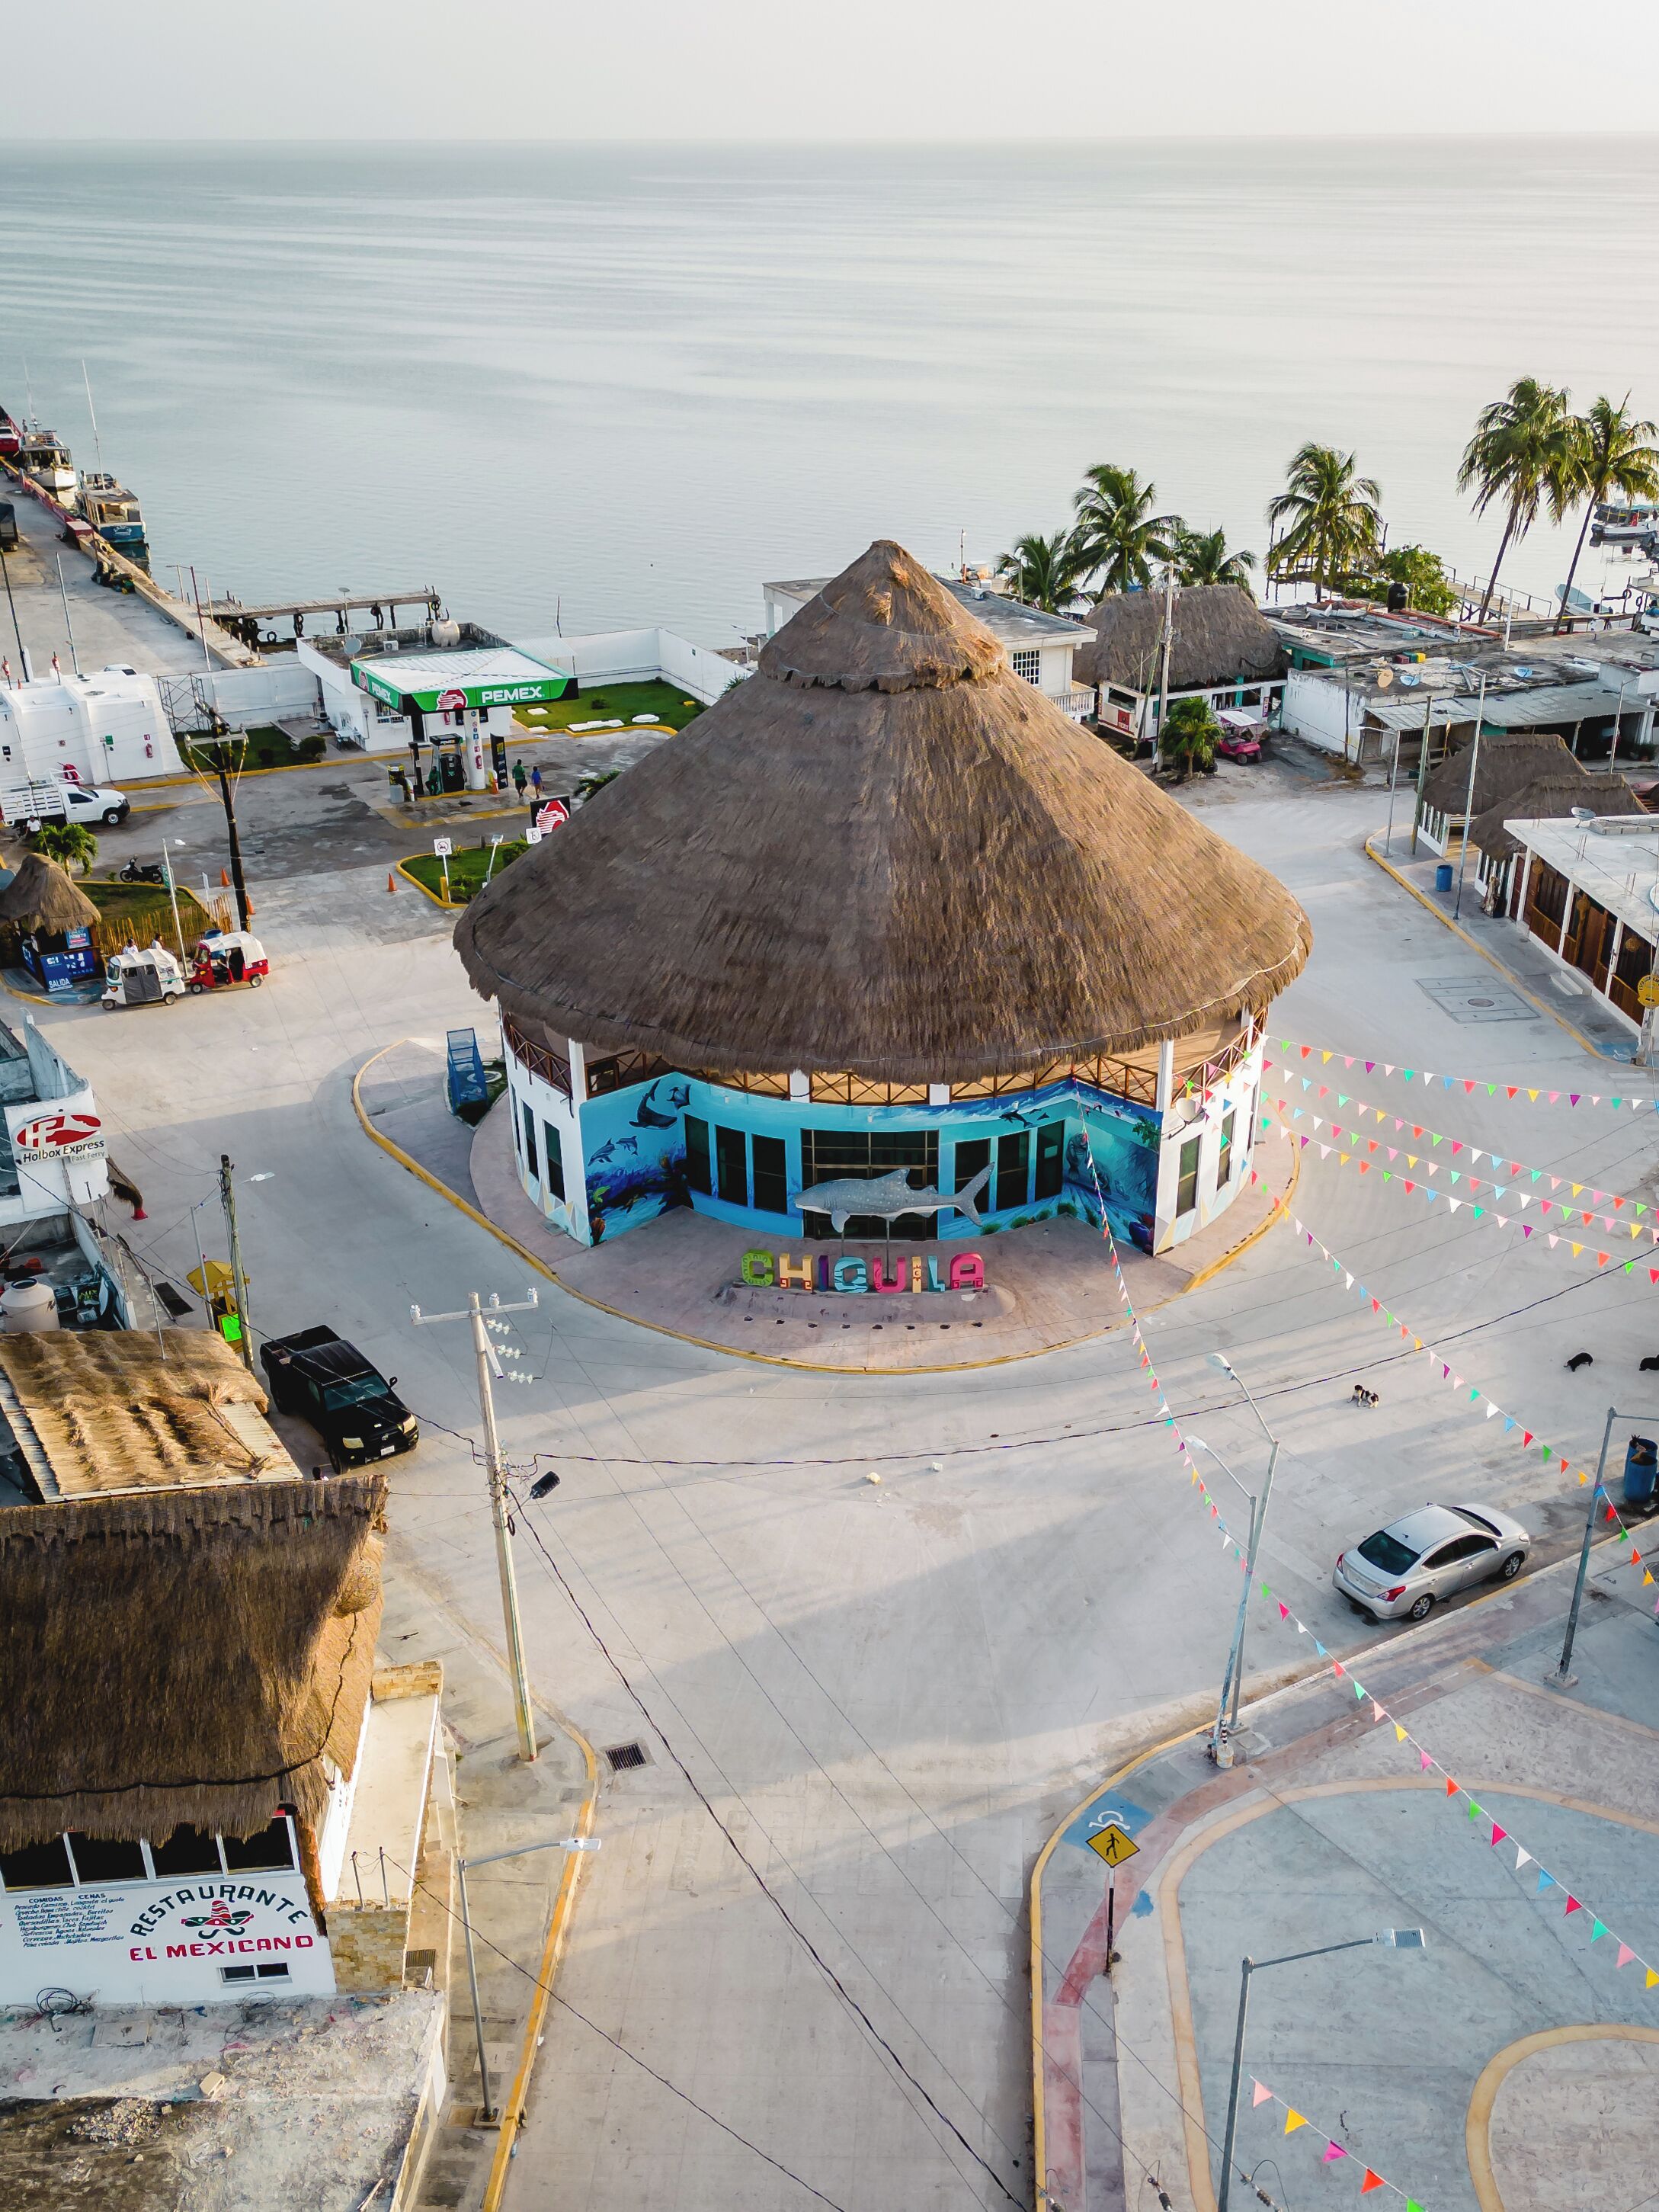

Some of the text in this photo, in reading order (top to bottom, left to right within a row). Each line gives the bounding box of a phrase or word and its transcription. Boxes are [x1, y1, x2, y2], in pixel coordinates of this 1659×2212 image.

[482, 686, 543, 704] PEMEX
[49, 978, 70, 989] SALIDA
[23, 1140, 104, 1163] Holbox Express
[741, 1249, 985, 1294] CHIQUILA
[130, 1884, 308, 1937] RESTAURANTE
[130, 1935, 314, 1961] EL MEXICANO
